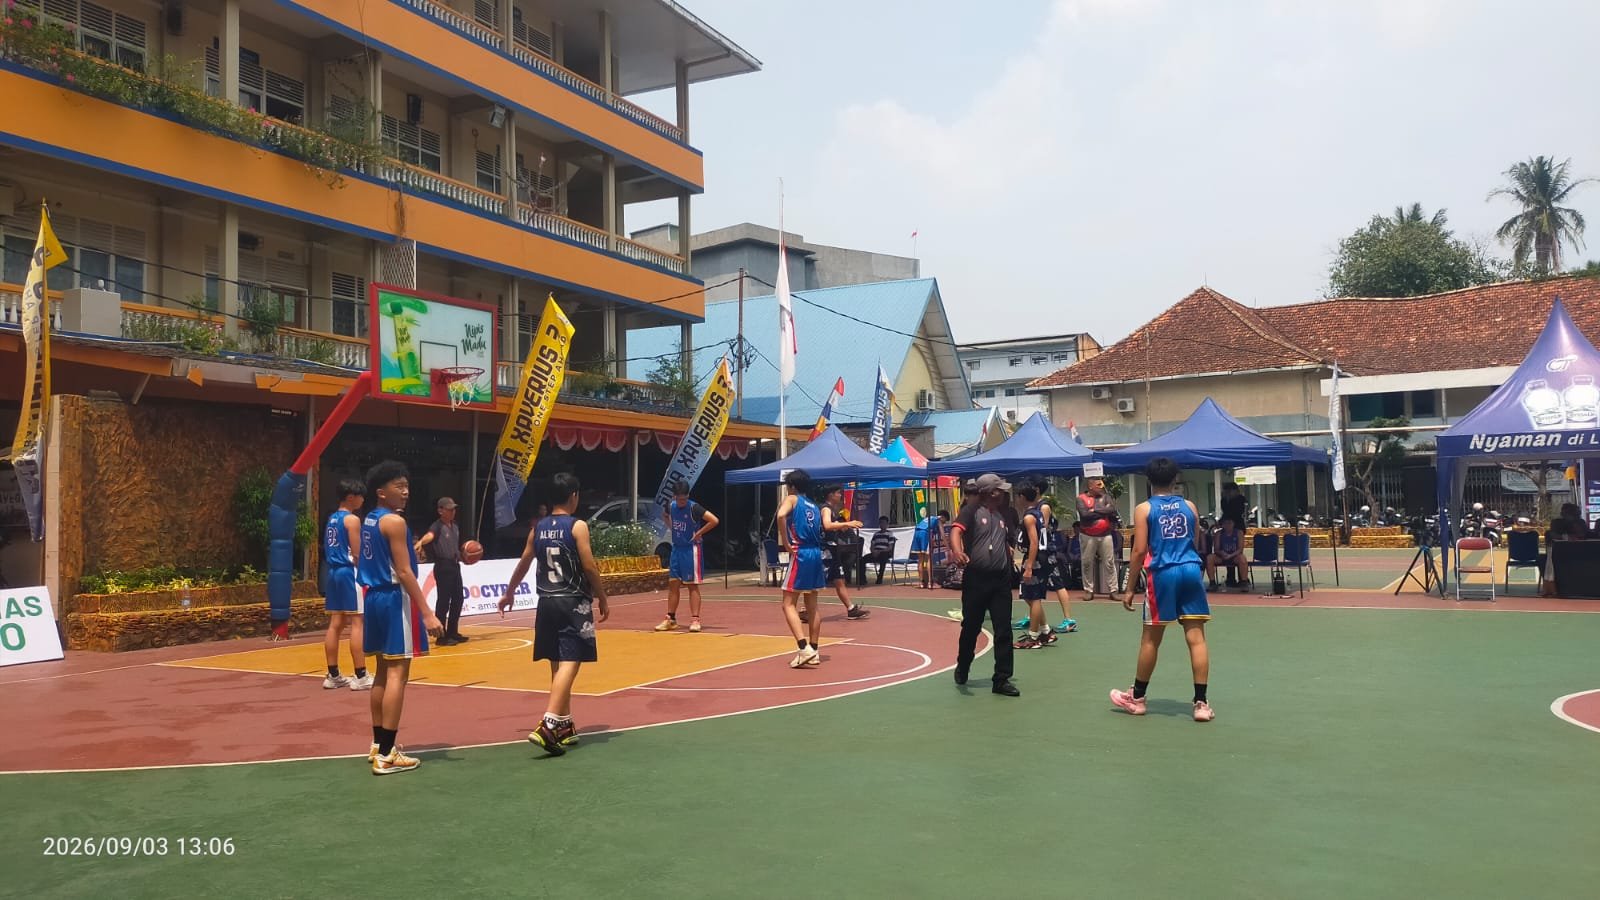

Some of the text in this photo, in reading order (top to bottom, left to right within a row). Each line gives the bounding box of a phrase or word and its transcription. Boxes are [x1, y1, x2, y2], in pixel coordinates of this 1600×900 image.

[464, 323, 484, 339] Nipis
[461, 335, 486, 355] Madu
[511, 345, 559, 444] XAVERIUS
[534, 405, 547, 427] ONE
[544, 375, 557, 401] STEP
[677, 391, 727, 469] XAVERIUS
[869, 390, 888, 454] XAVERIUS
[1469, 433, 1562, 453] Nyaman
[1567, 433, 1585, 445] di
[1158, 512, 1188, 539] 23
[546, 546, 564, 584] 5
[0, 596, 43, 619] AS
[514, 597, 535, 607] tabil
